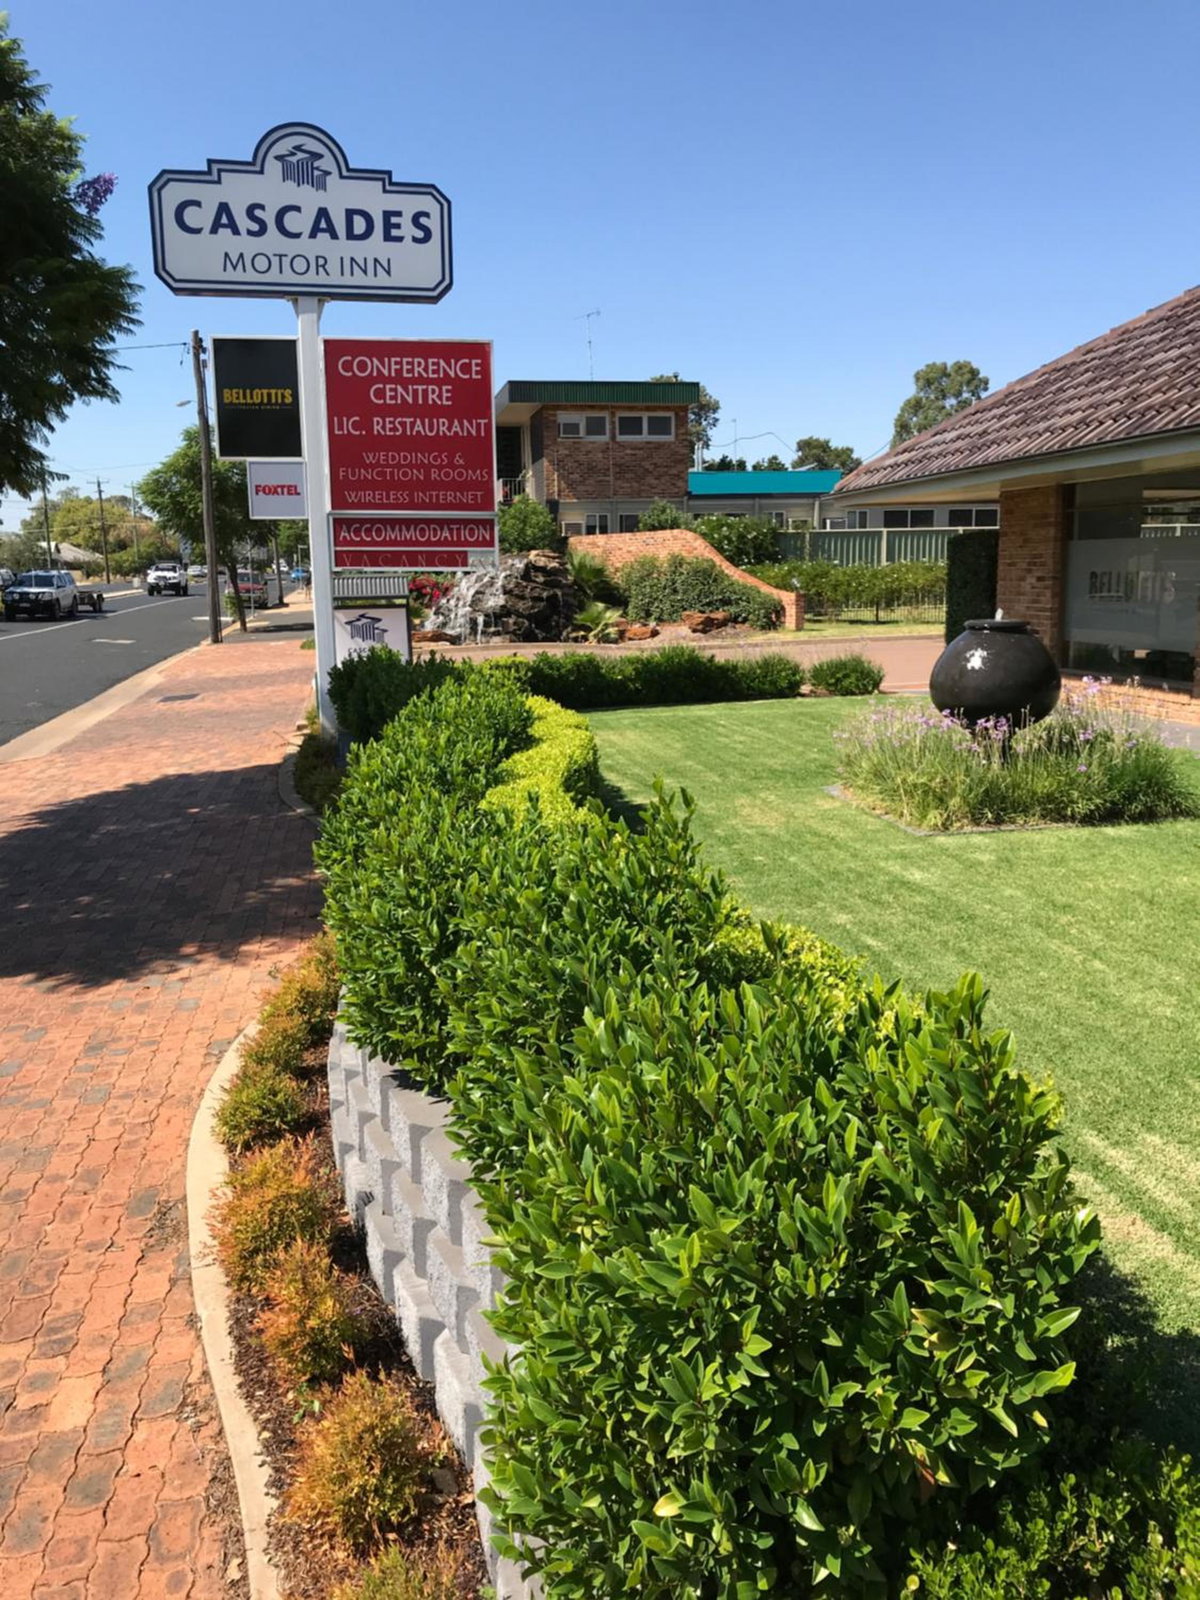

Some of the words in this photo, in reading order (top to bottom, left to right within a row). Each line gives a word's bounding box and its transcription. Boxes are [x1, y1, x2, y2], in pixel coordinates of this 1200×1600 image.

[173, 199, 433, 245] CASCADES
[222, 251, 330, 276] MOTOR
[339, 256, 392, 278] INN
[338, 355, 482, 379] CONFERENCE
[223, 388, 293, 403] BELLOTTI'S
[370, 384, 453, 405] CENTRE
[333, 417, 366, 436] LIC.
[373, 418, 489, 437] RESTAURANT
[362, 452, 448, 465] WEDDINGS
[454, 452, 465, 465] &
[339, 468, 425, 481] FUNCTION
[430, 468, 489, 481] ROOMS
[255, 485, 301, 496] FOXTEL
[345, 491, 409, 504] WIRELESS
[414, 491, 484, 504] INTERNET
[339, 524, 491, 542] ACCOMMODATION
[342, 553, 466, 567] VACANCY
